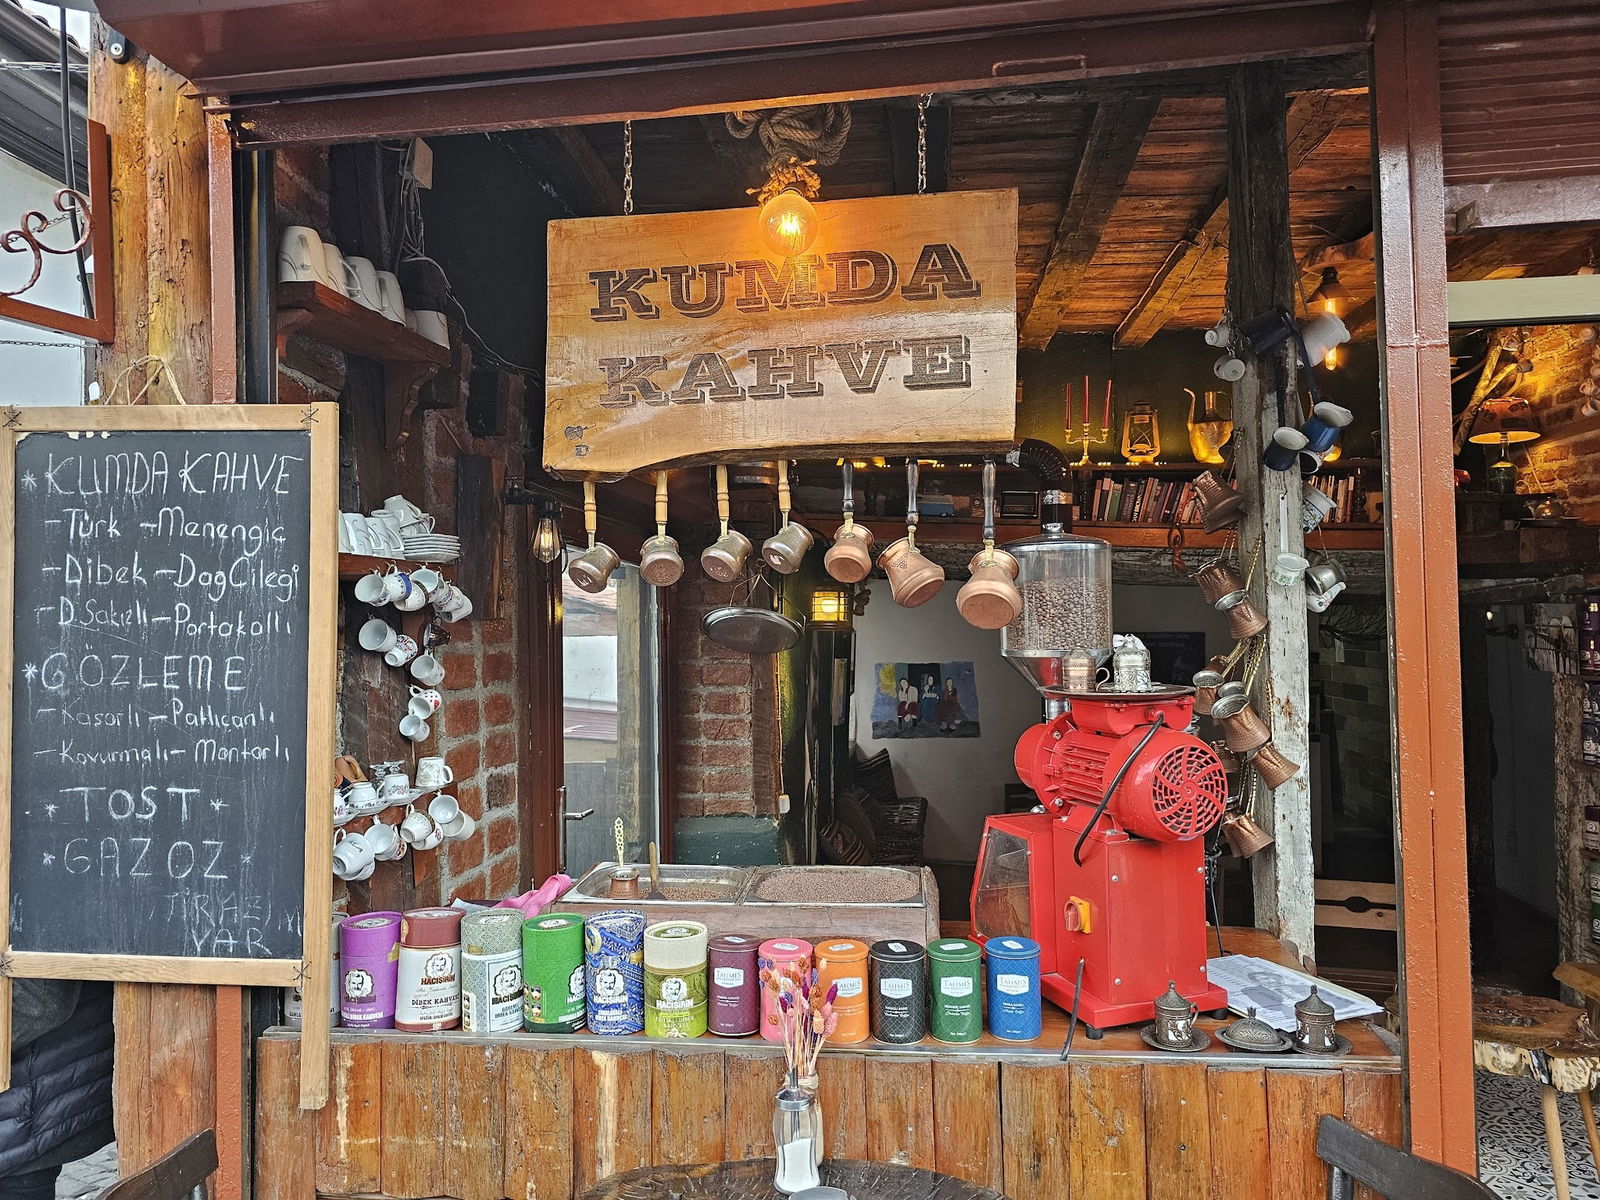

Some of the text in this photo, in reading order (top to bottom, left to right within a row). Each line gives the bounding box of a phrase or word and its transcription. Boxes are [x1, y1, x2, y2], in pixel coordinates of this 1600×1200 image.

[588, 243, 982, 323] KUMDA
[599, 335, 972, 409] KAHVE
[45, 450, 304, 495] KUMDA KAHVE
[41, 644, 246, 691] GÖZLEME
[59, 786, 201, 823] TOST
[64, 837, 229, 880] GAZOZ
[191, 927, 273, 955] VAR
